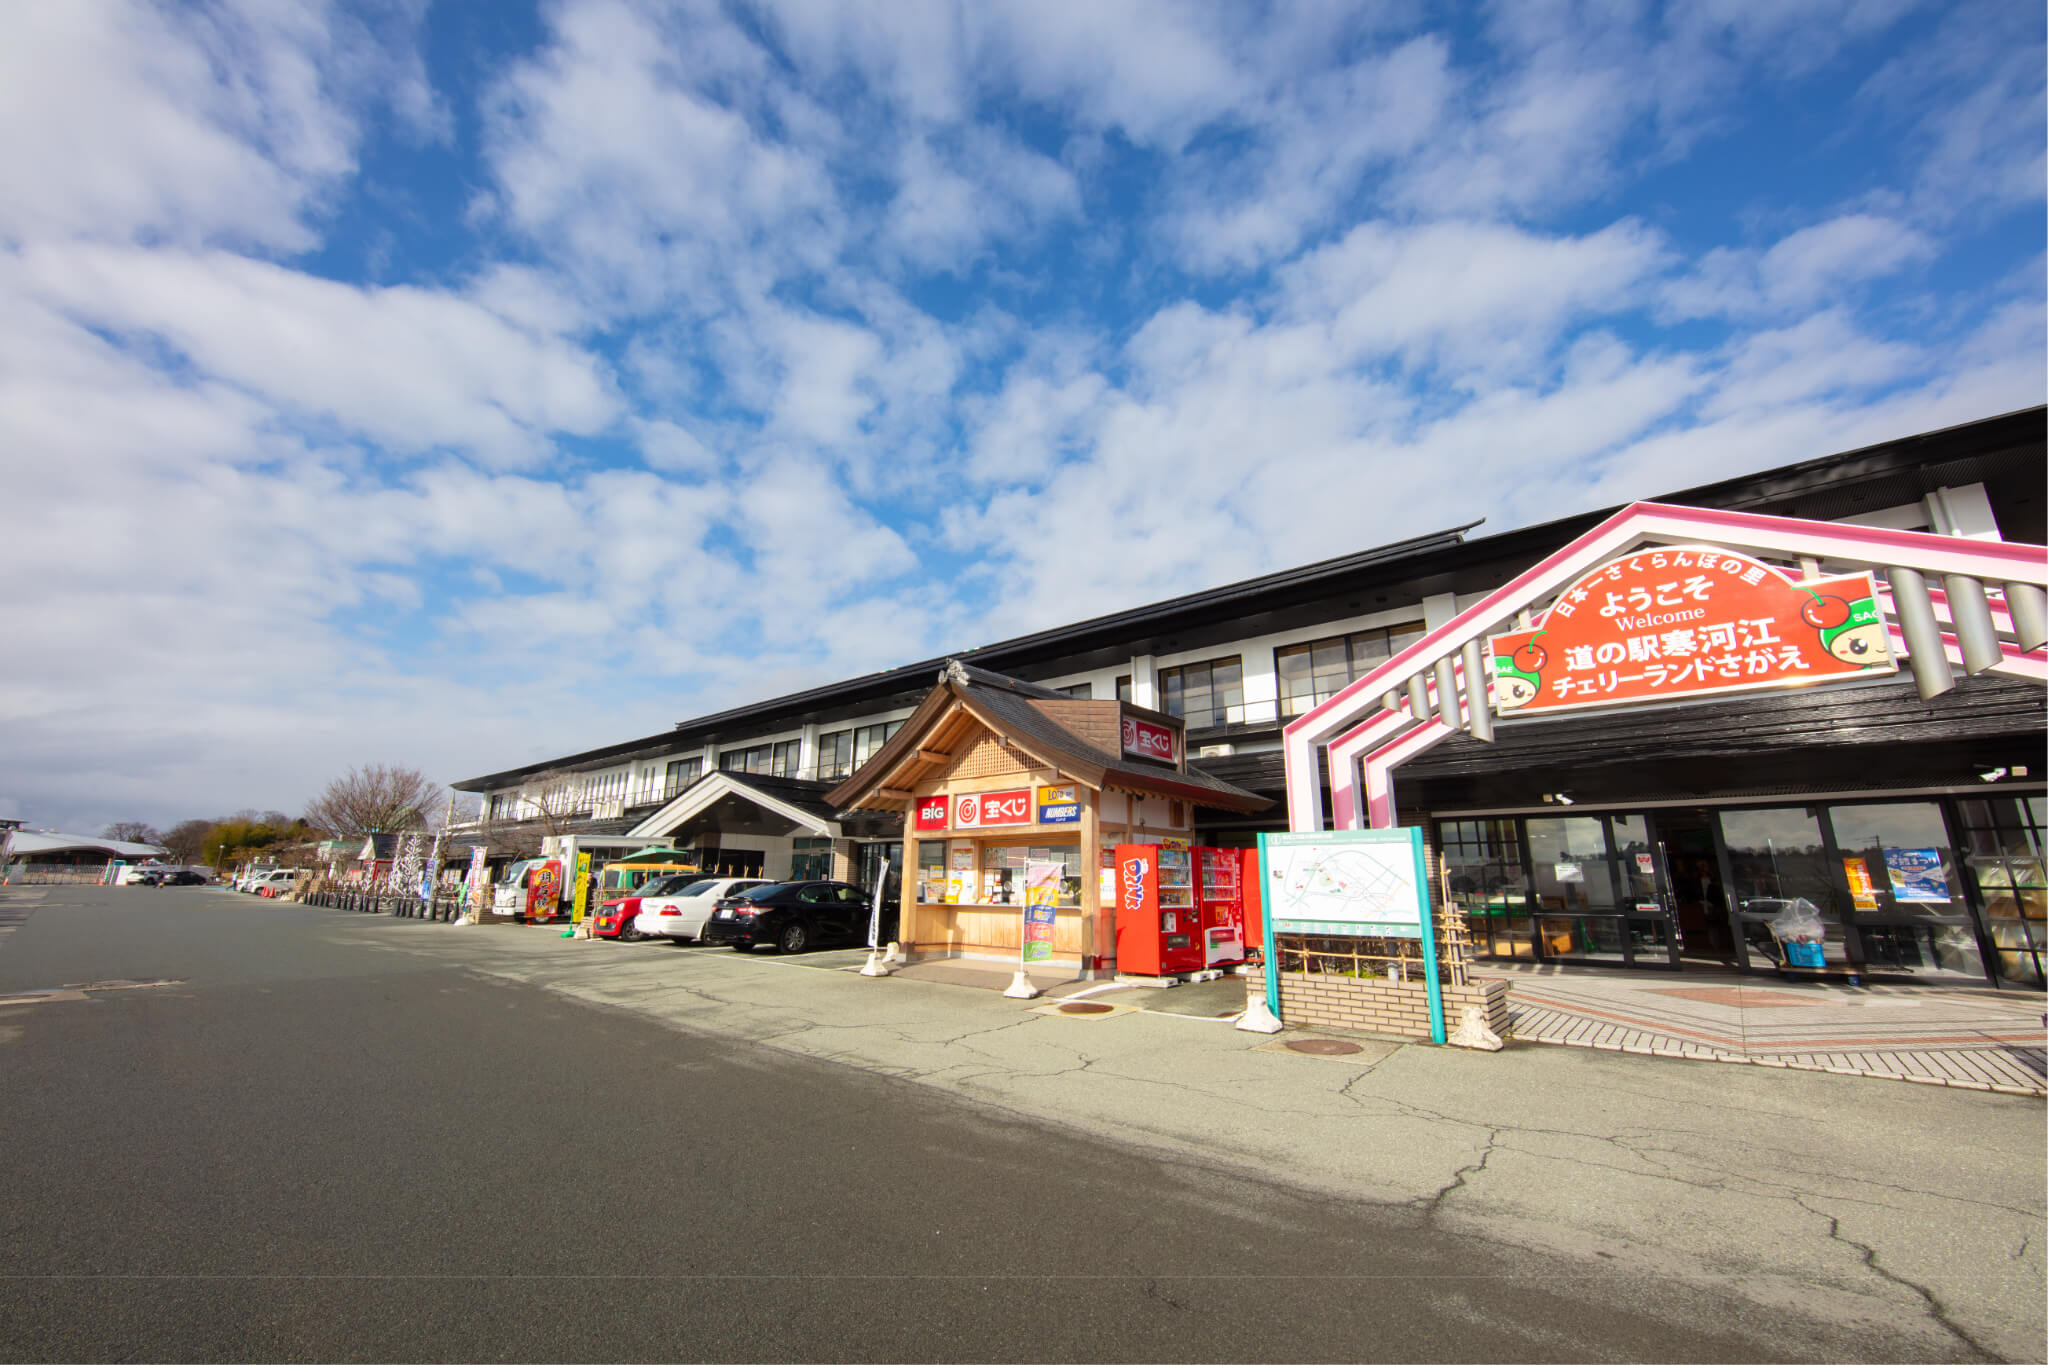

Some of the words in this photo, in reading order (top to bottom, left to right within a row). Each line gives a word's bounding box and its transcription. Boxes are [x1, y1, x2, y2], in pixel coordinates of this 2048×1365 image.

[1555, 551, 1767, 618] 日本一さくらんぼの里
[1599, 574, 1715, 618] ようこそ
[1614, 607, 1706, 632] Welcome
[1564, 617, 1781, 672] 道の駅寒河江
[1552, 645, 1811, 699] チェリーランドさがえ
[1139, 729, 1169, 752] 宝くじ
[984, 797, 1027, 819] 宝くじ
[1045, 806, 1078, 819] NUMBERS
[1123, 858, 1144, 910] DRINK
